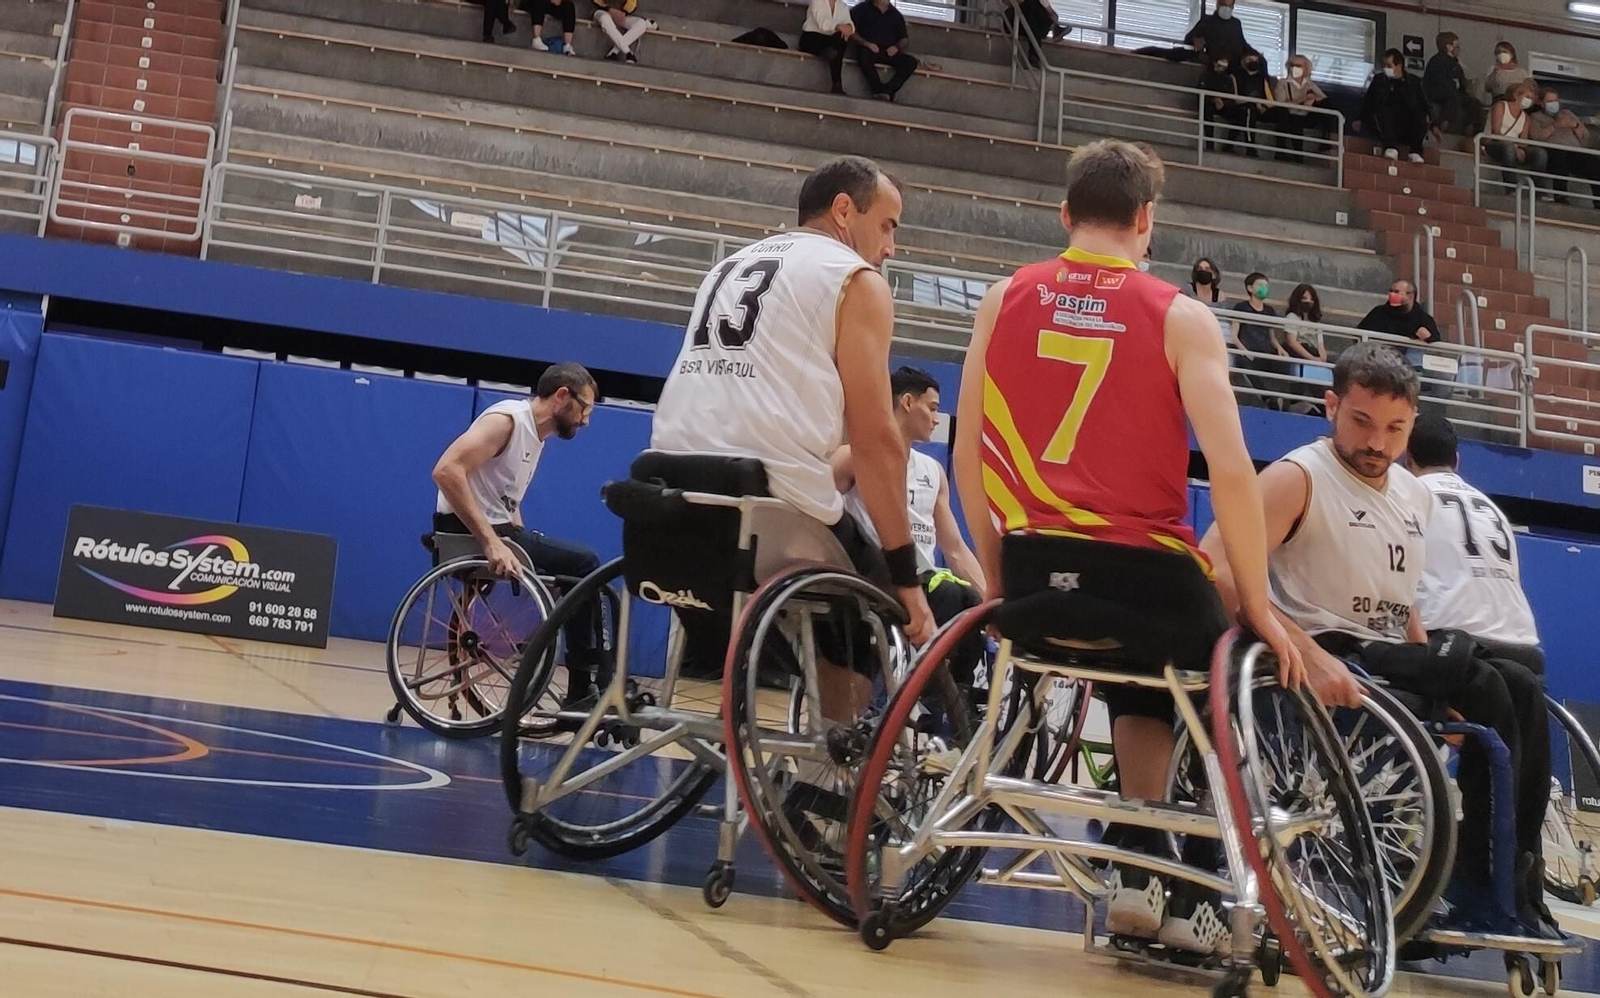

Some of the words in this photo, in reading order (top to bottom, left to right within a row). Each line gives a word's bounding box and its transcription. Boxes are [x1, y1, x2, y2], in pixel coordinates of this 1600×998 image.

[690, 257, 783, 351] 13
[1057, 294, 1105, 313] aspim
[1037, 329, 1114, 465] 7
[1387, 543, 1406, 573] 12
[190, 572, 261, 589] COMUNICACIÓN
[262, 580, 292, 593] VISUAL
[125, 603, 231, 624] www.rotulossystem.com
[249, 601, 262, 613] 91
[265, 603, 285, 616] 609
[287, 606, 302, 618] 28
[303, 607, 317, 619] 58
[1352, 596, 1371, 613] 20
[249, 615, 269, 627] 669
[272, 617, 292, 630] 783
[294, 620, 313, 632] 791
